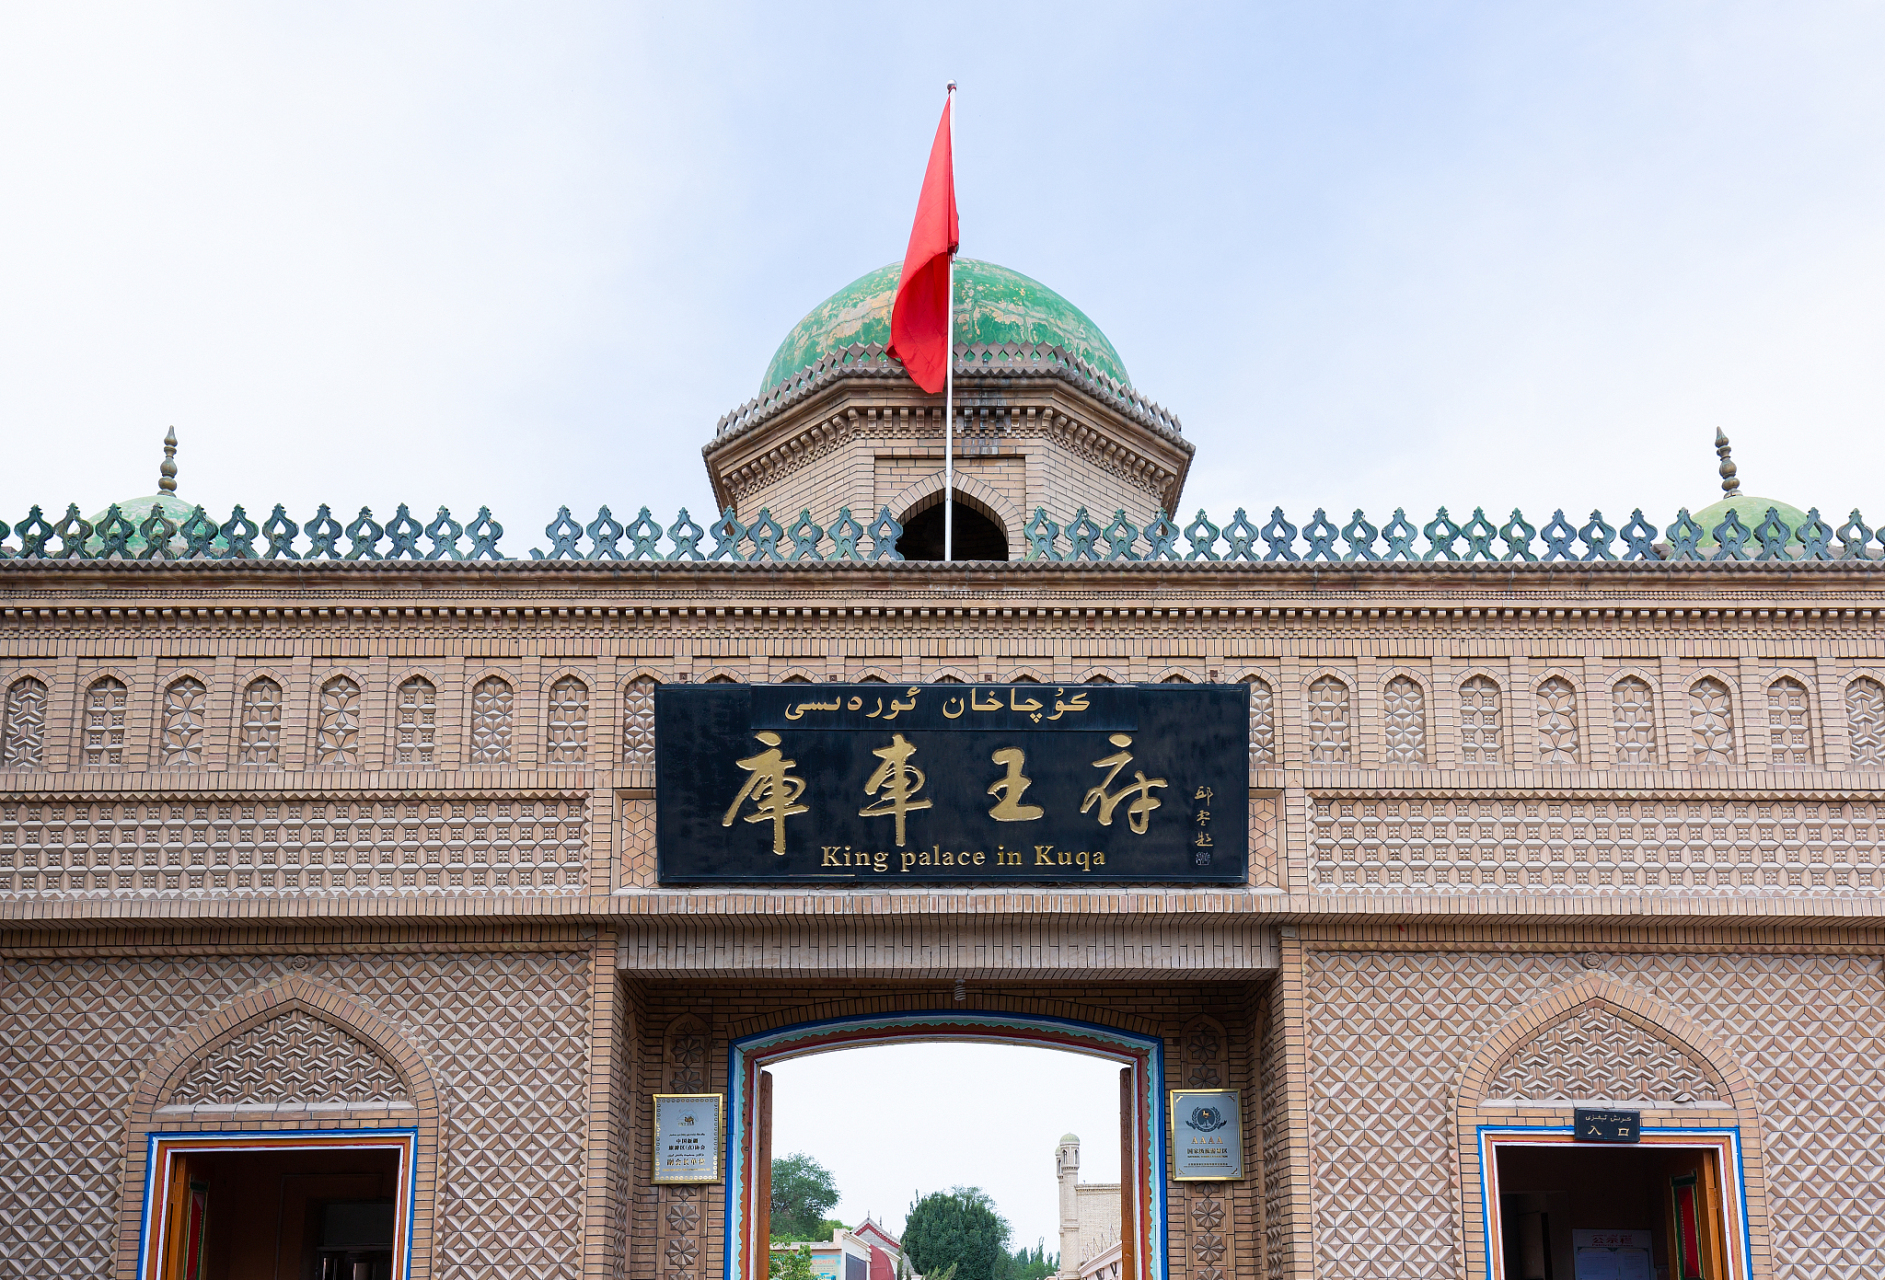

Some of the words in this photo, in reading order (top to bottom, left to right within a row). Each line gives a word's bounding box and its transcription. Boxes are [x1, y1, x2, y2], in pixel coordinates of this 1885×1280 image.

[784, 686, 922, 721] ئوردىسى
[820, 845, 889, 872] King
[900, 844, 986, 872] palace
[996, 844, 1023, 866] in
[1034, 845, 1107, 872] Kuqa
[1587, 1125, 1630, 1137] 入口
